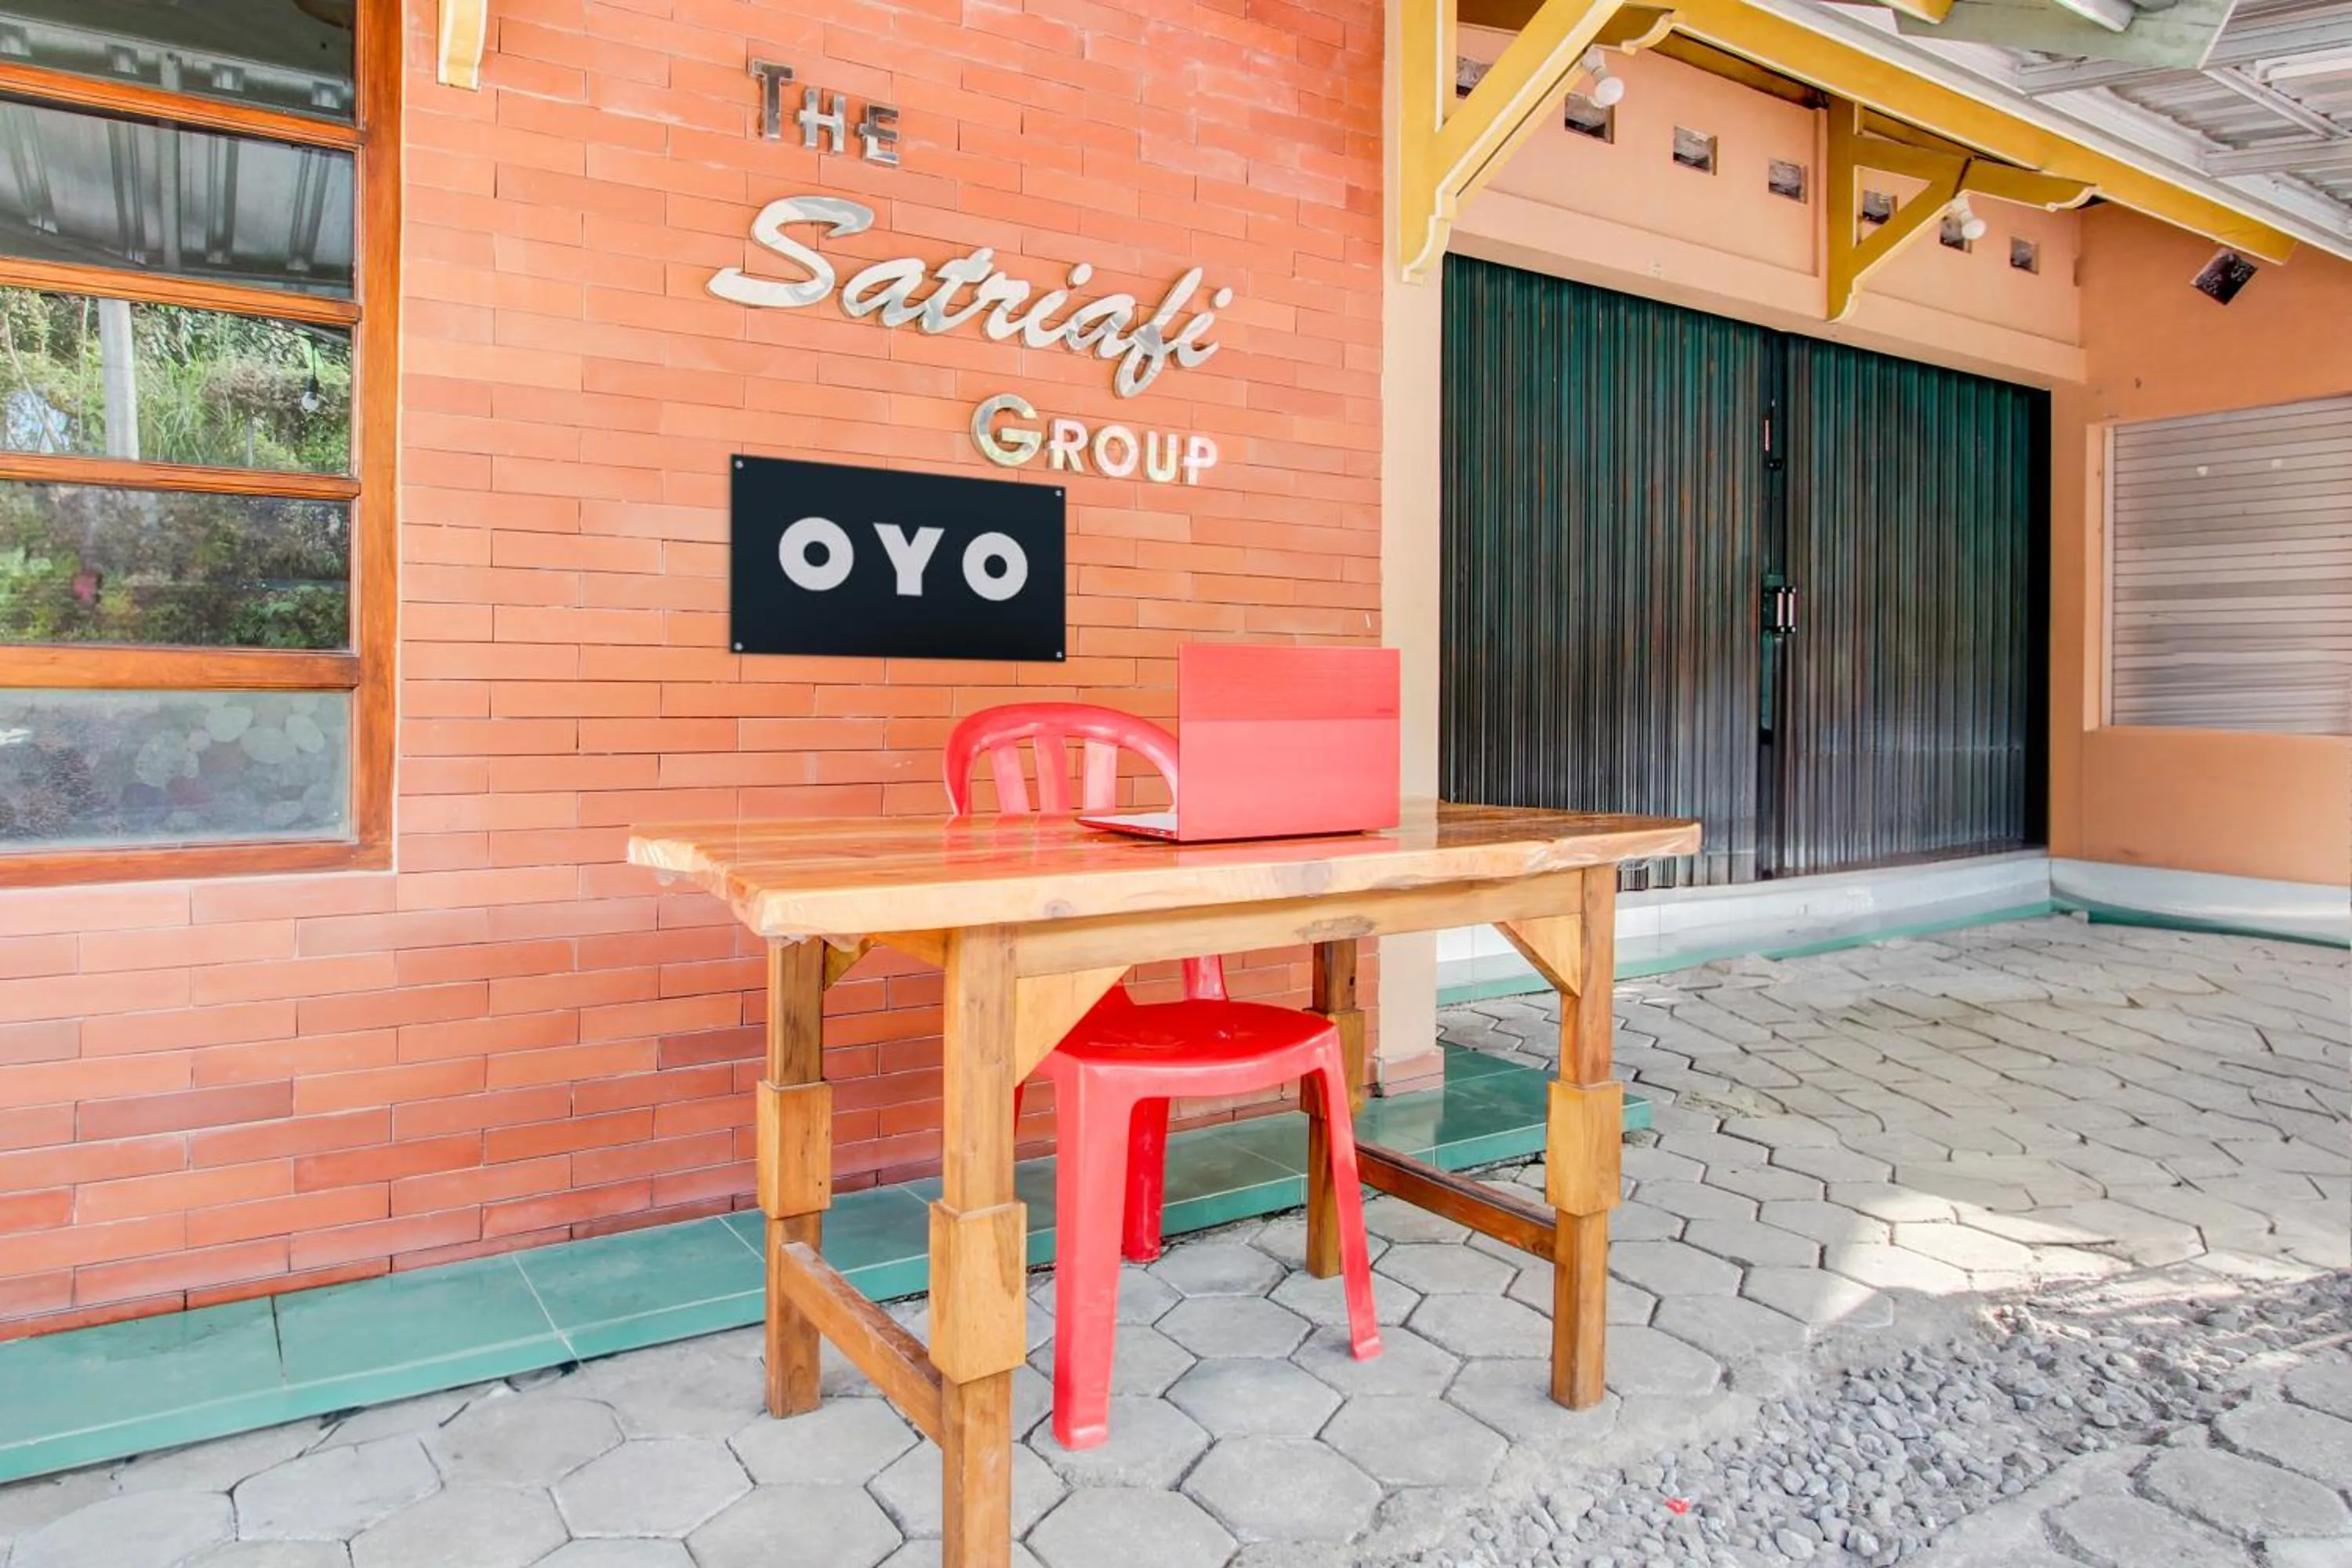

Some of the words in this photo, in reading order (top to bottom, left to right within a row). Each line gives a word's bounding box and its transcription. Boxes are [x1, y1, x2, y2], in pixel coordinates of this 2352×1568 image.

[749, 60, 900, 164] THE
[706, 196, 1233, 397] Satriafi
[971, 394, 1219, 485] GROUP
[779, 517, 1029, 601] OYO
